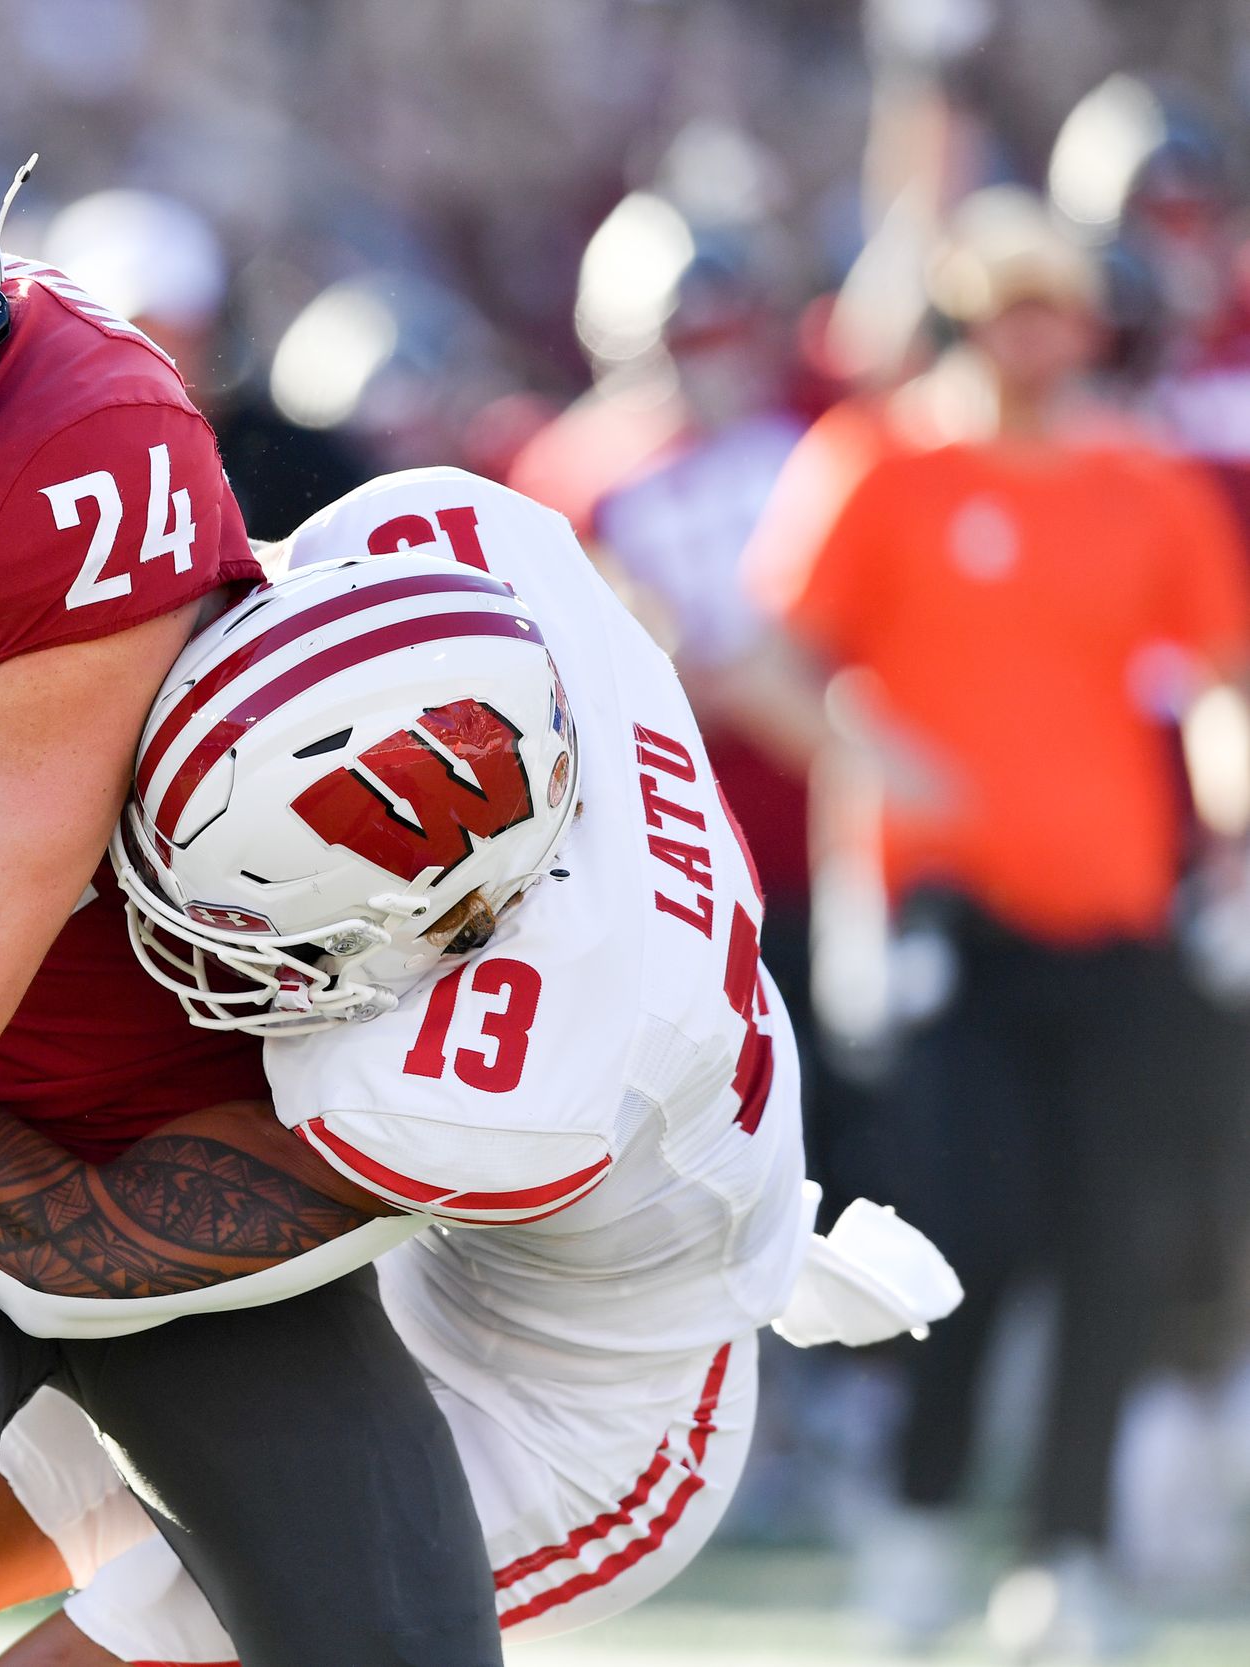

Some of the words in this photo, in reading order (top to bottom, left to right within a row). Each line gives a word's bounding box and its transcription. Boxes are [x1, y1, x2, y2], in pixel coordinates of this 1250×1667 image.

[37, 443, 197, 611] 24
[289, 697, 535, 888] W
[633, 721, 714, 941] LATU
[403, 957, 542, 1093] 13
